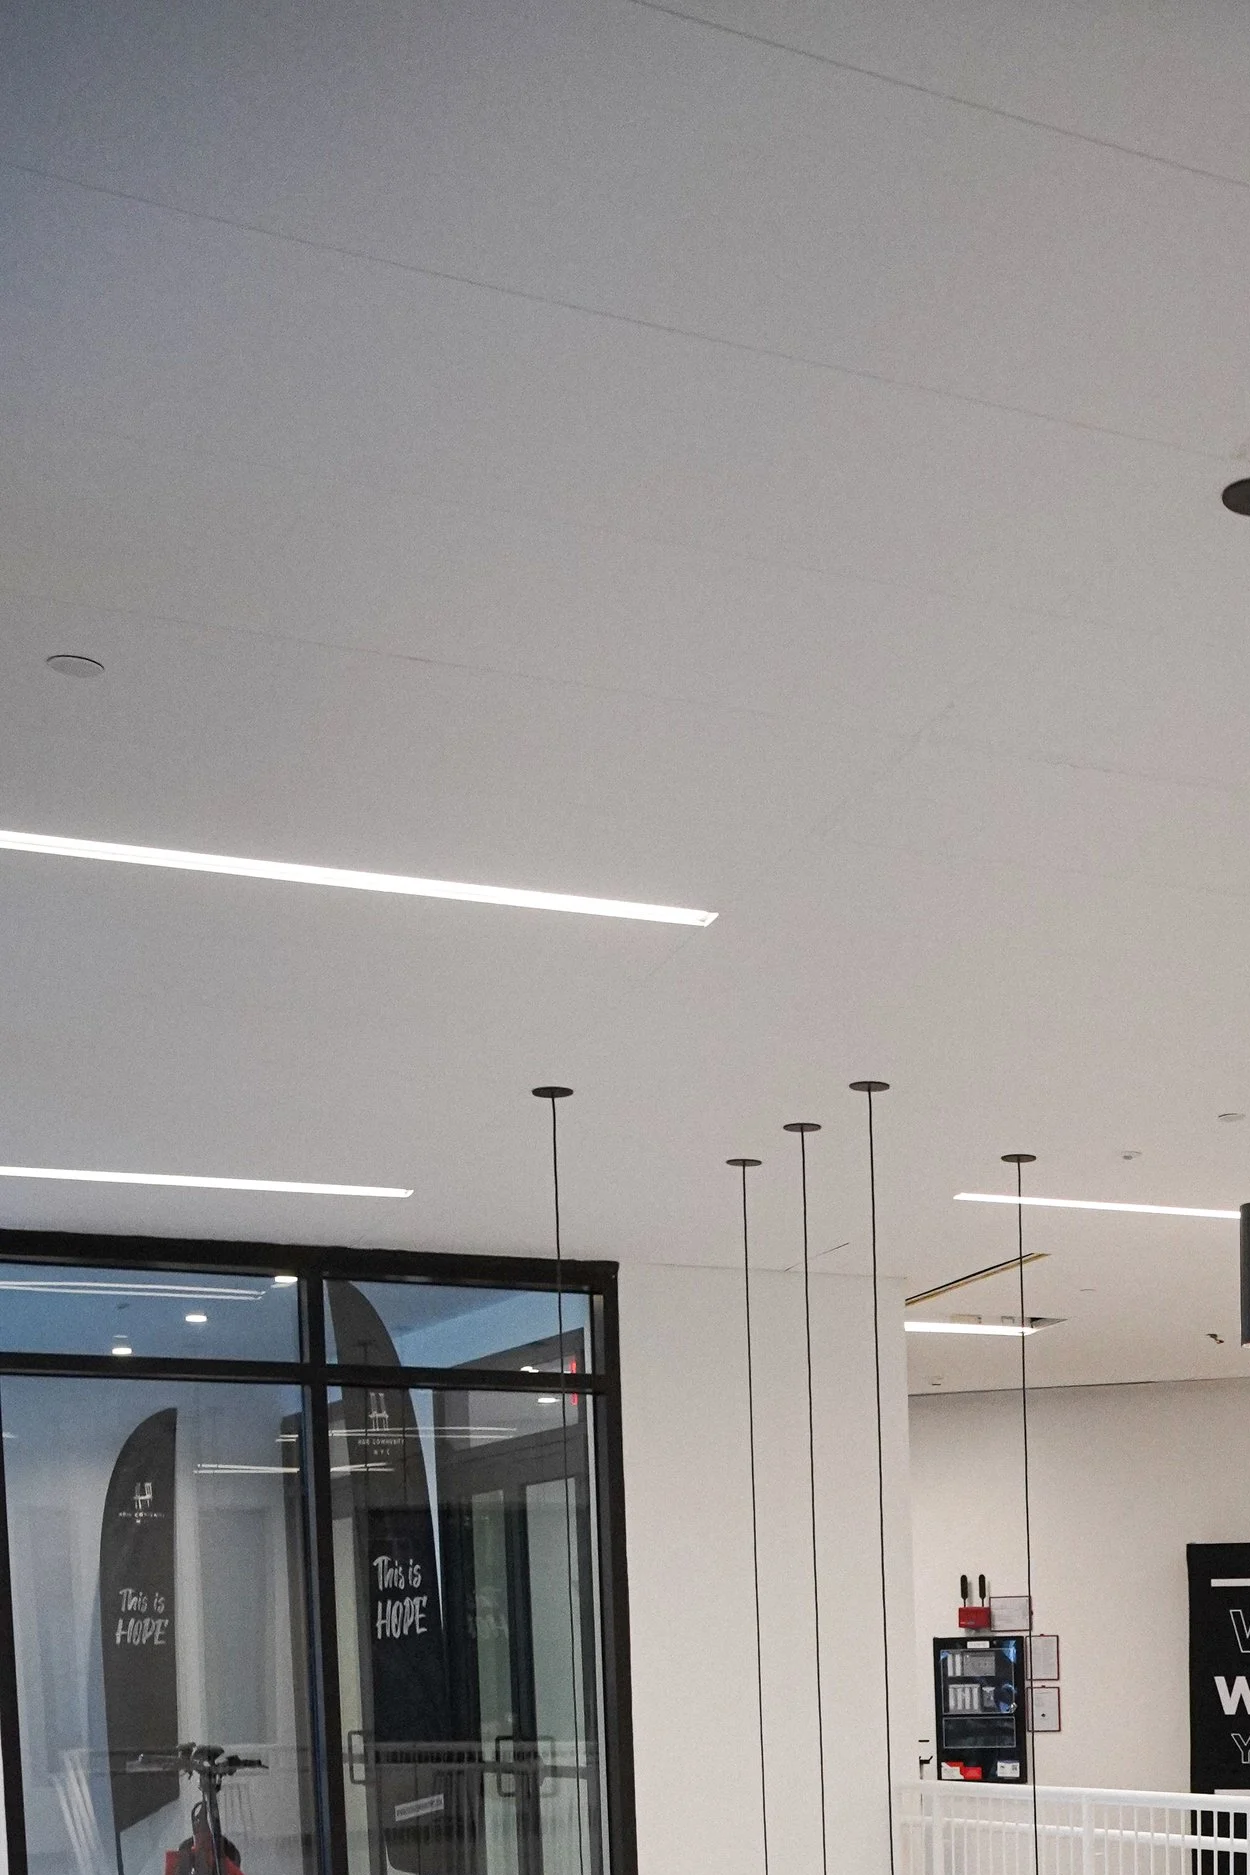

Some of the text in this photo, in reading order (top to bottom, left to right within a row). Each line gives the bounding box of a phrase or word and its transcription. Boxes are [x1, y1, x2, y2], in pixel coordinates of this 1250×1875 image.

[372, 1555, 422, 1592] This is
[118, 1587, 166, 1615] This is
[375, 1595, 429, 1640] HOPE
[114, 1617, 170, 1646] HOPE
